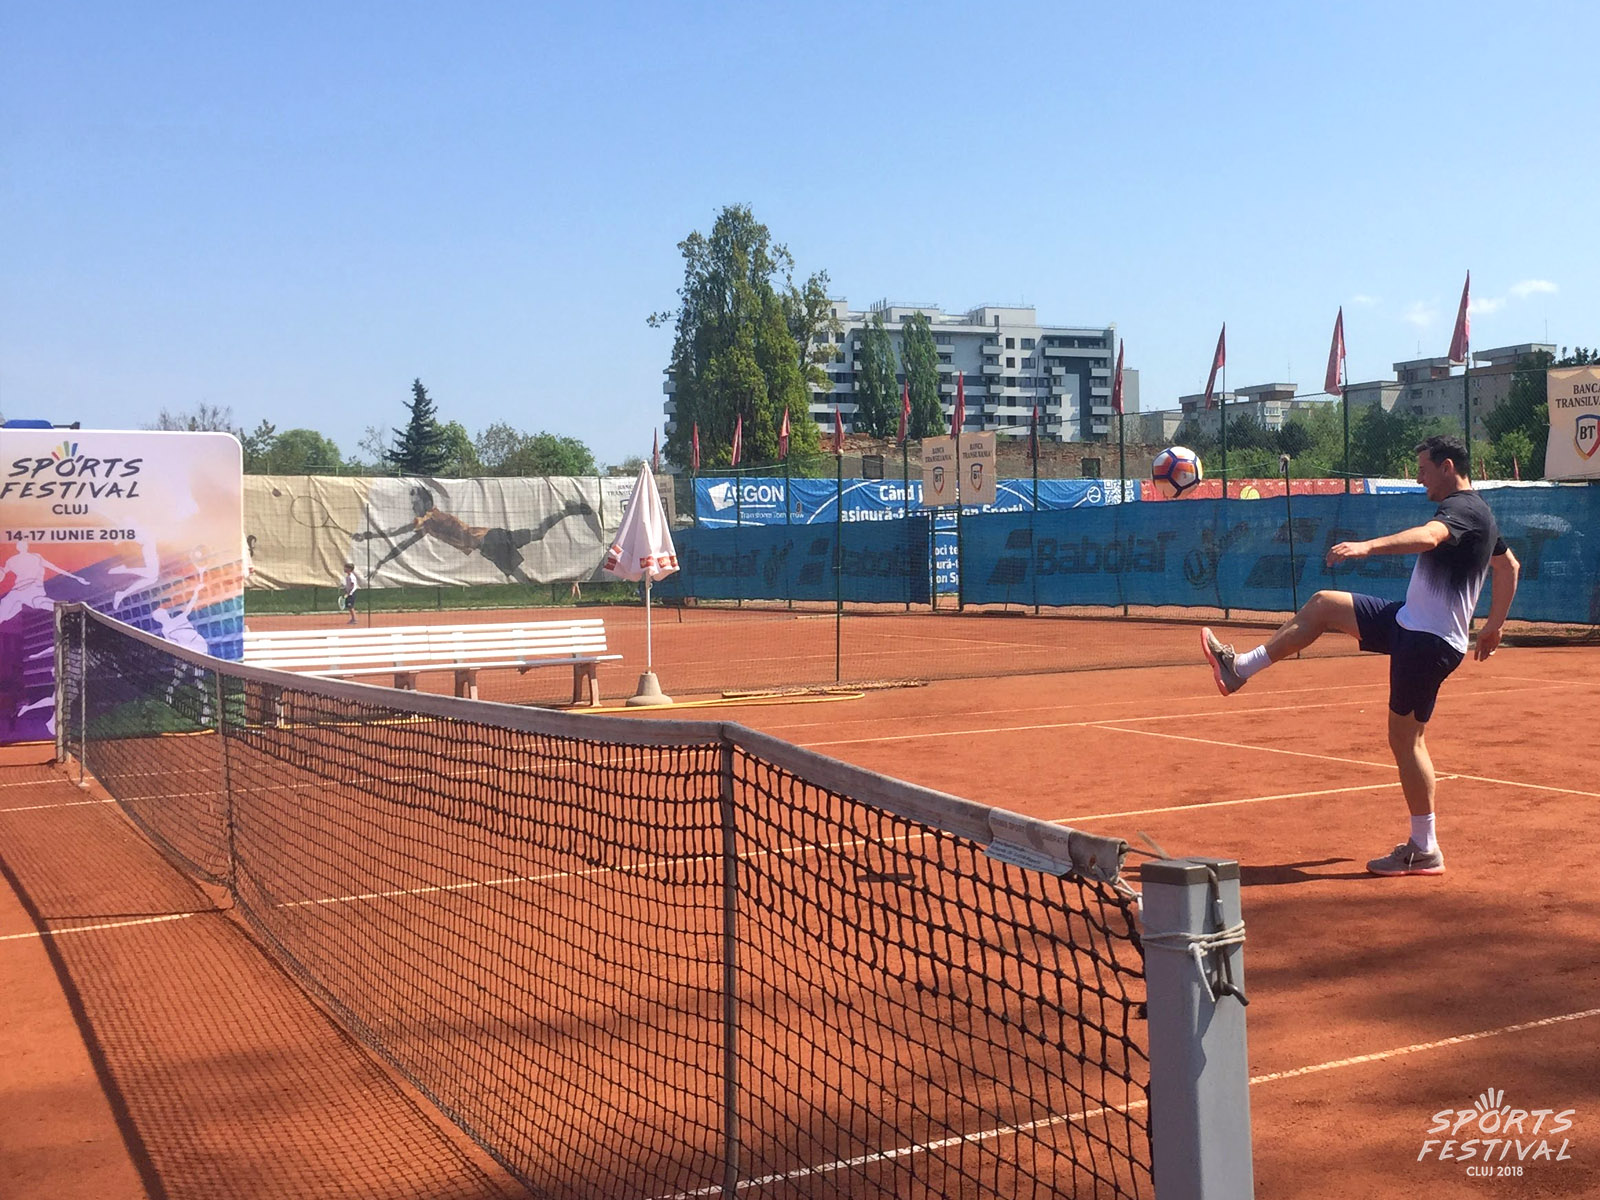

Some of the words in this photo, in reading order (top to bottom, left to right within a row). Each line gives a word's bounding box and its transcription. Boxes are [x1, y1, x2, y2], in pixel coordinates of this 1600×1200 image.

[1580, 426, 1596, 440] BT
[8, 454, 144, 479] SPORTS
[0, 481, 140, 499] FESTIVAL
[723, 485, 785, 502] AEGON
[879, 484, 915, 502] Când
[52, 504, 89, 515] CLUJ
[5, 530, 46, 541] 14-17
[50, 530, 95, 541] IUNIE
[99, 529, 136, 540] 2018
